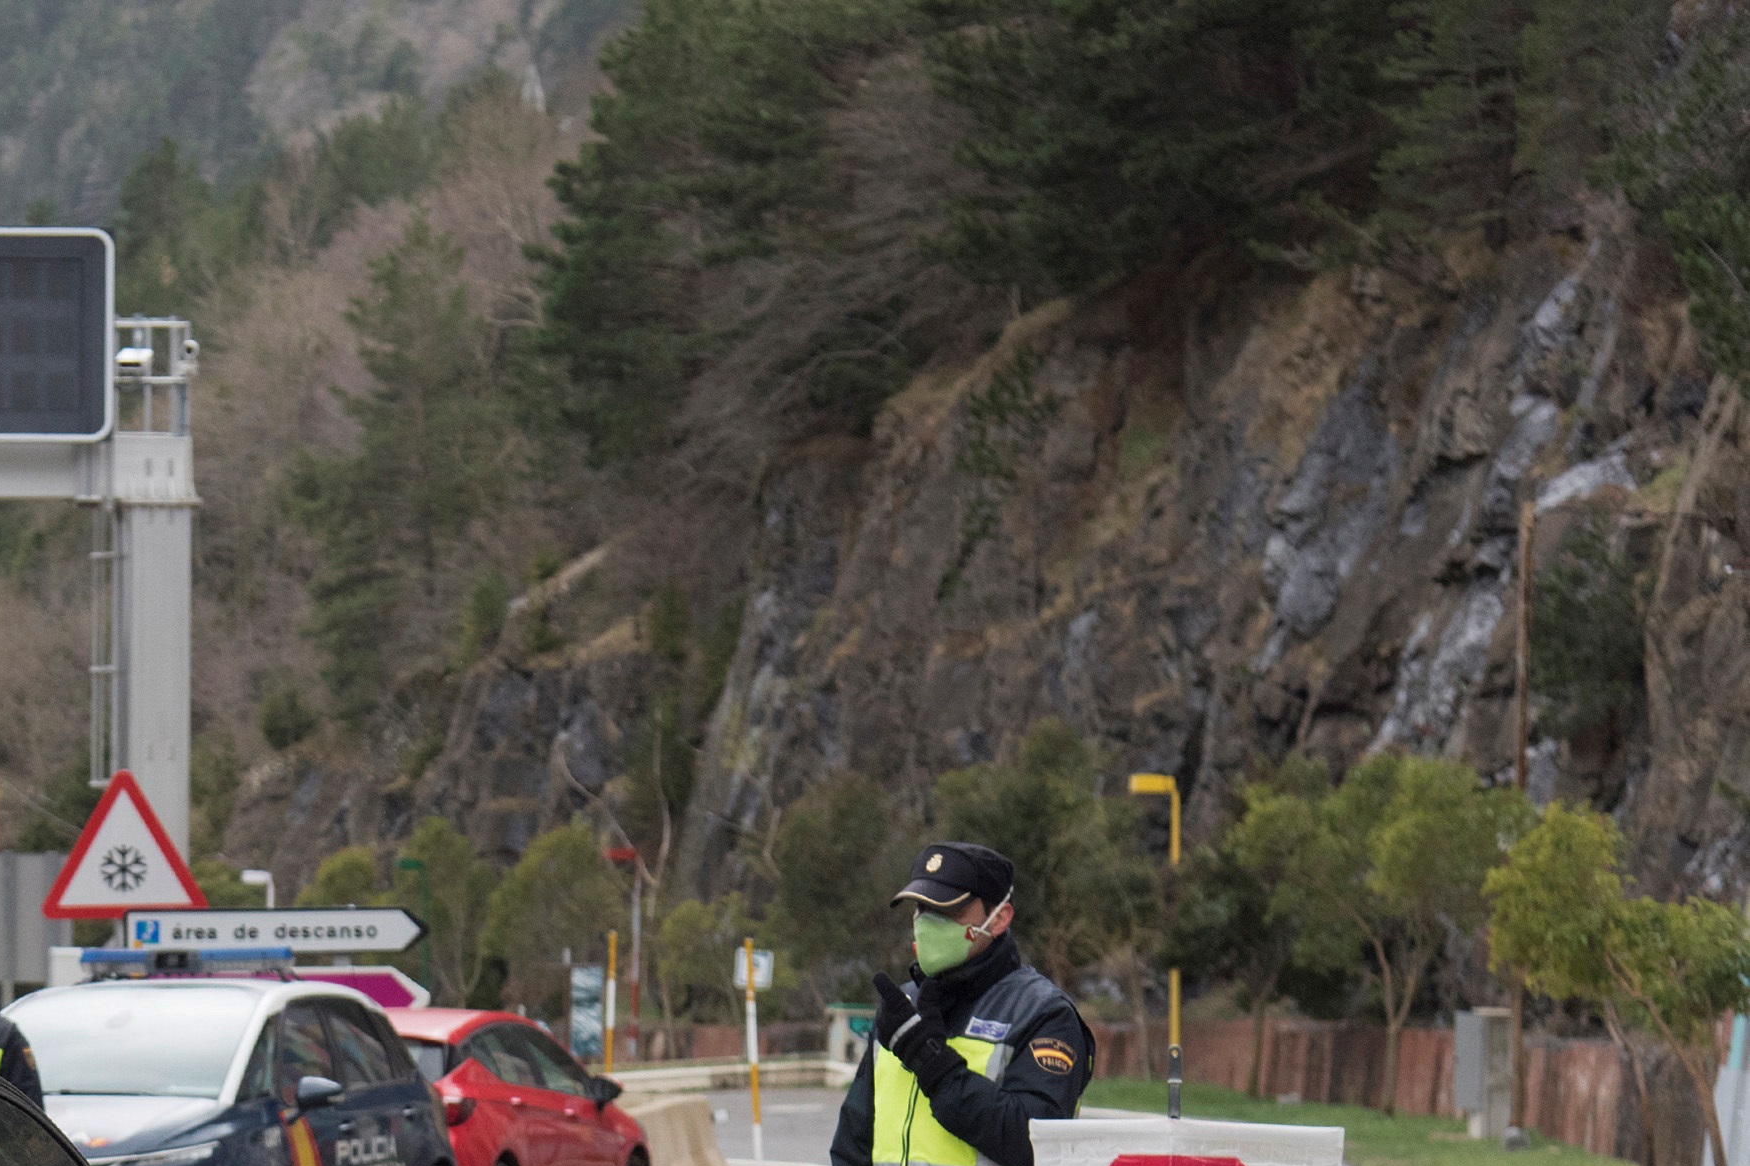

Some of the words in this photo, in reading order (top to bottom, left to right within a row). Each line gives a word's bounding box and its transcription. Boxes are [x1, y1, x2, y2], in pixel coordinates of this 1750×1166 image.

[172, 922, 217, 940] área
[234, 923, 259, 940] de
[275, 923, 378, 940] descanso
